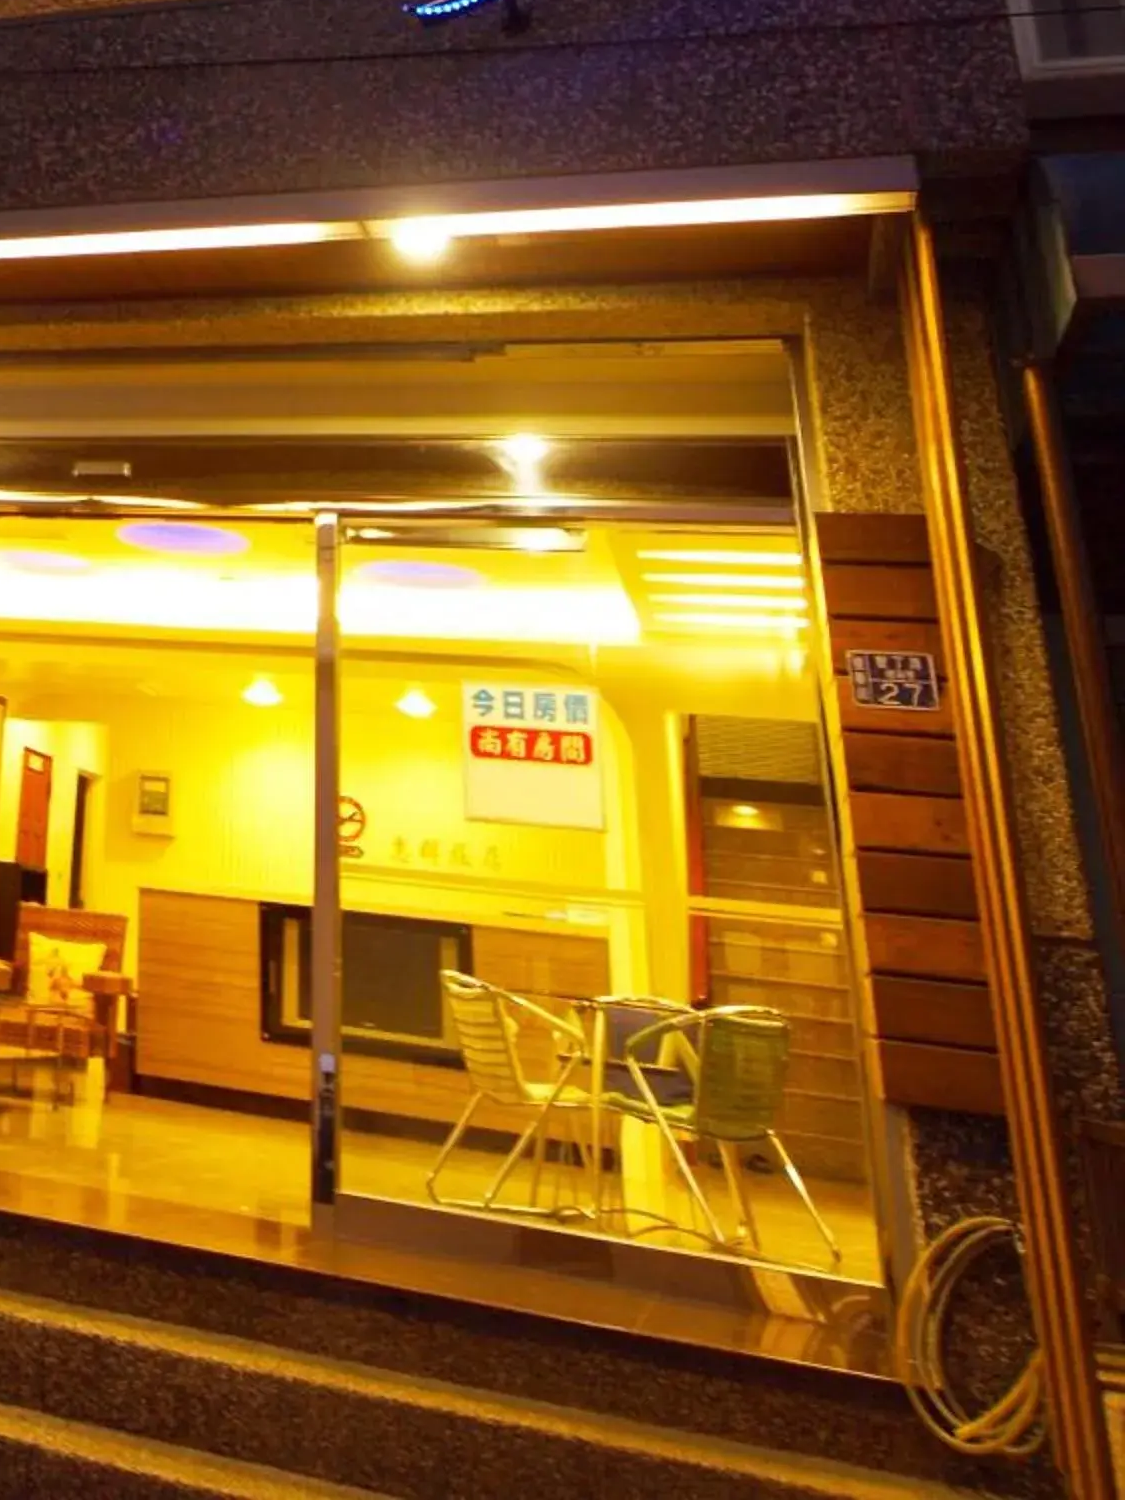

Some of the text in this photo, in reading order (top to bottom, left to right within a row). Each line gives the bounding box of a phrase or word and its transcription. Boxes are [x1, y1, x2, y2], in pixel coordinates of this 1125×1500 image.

[471, 688, 589, 725] 今日房價
[877, 682, 923, 708] 27
[477, 729, 586, 763] 尚有房間
